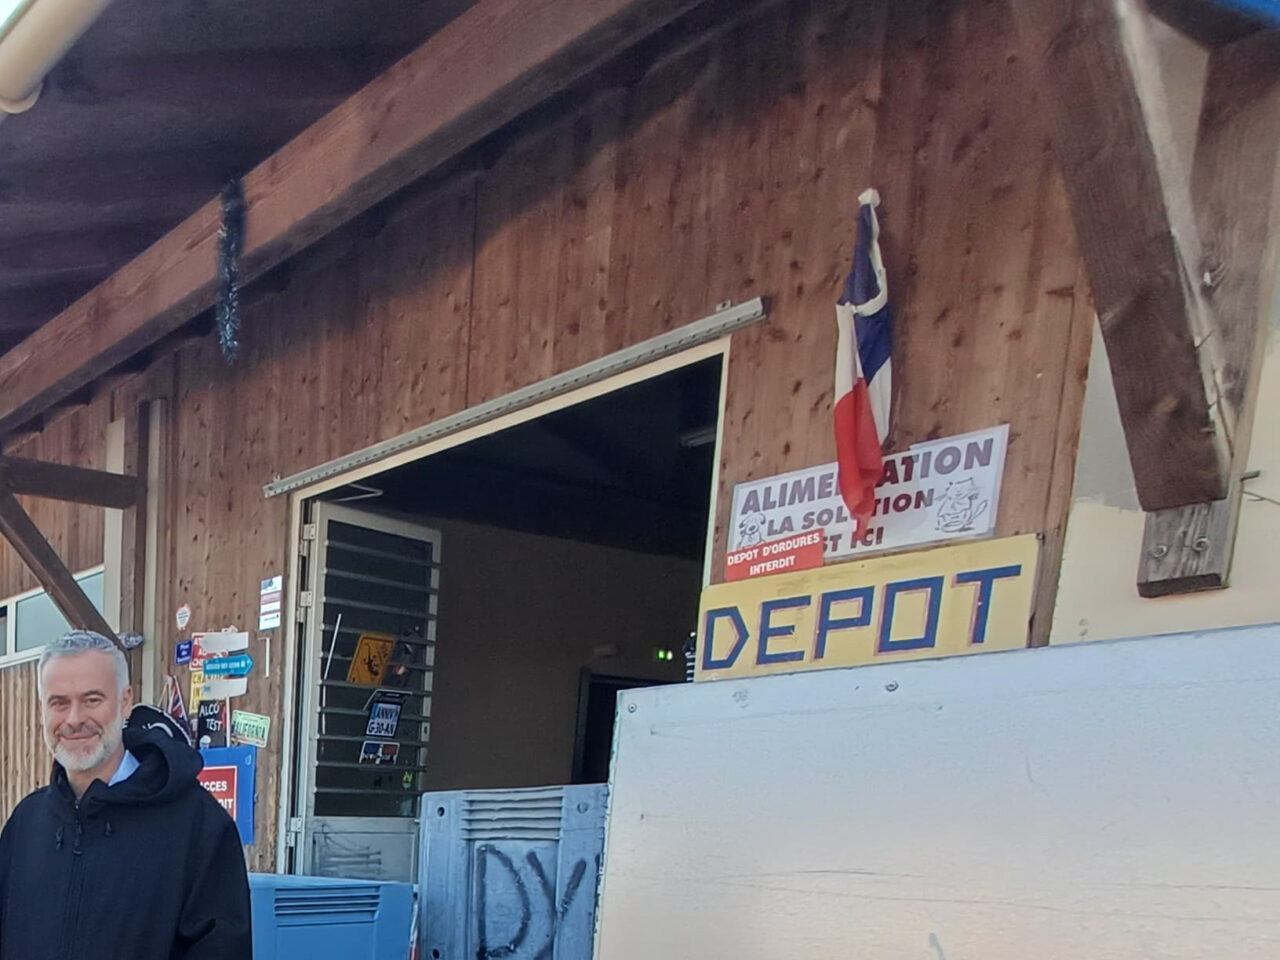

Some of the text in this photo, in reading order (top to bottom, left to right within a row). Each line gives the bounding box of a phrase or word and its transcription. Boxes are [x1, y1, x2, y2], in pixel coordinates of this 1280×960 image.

[740, 438, 995, 516] ALIMEATION
[767, 488, 935, 537] LA SOLTION
[727, 532, 820, 566] DEPOT D'ORDURES
[749, 555, 796, 576] INTERDIT
[701, 564, 1022, 671] DEPOT
[199, 703, 220, 718] ALCO
[206, 718, 222, 731] TEST
